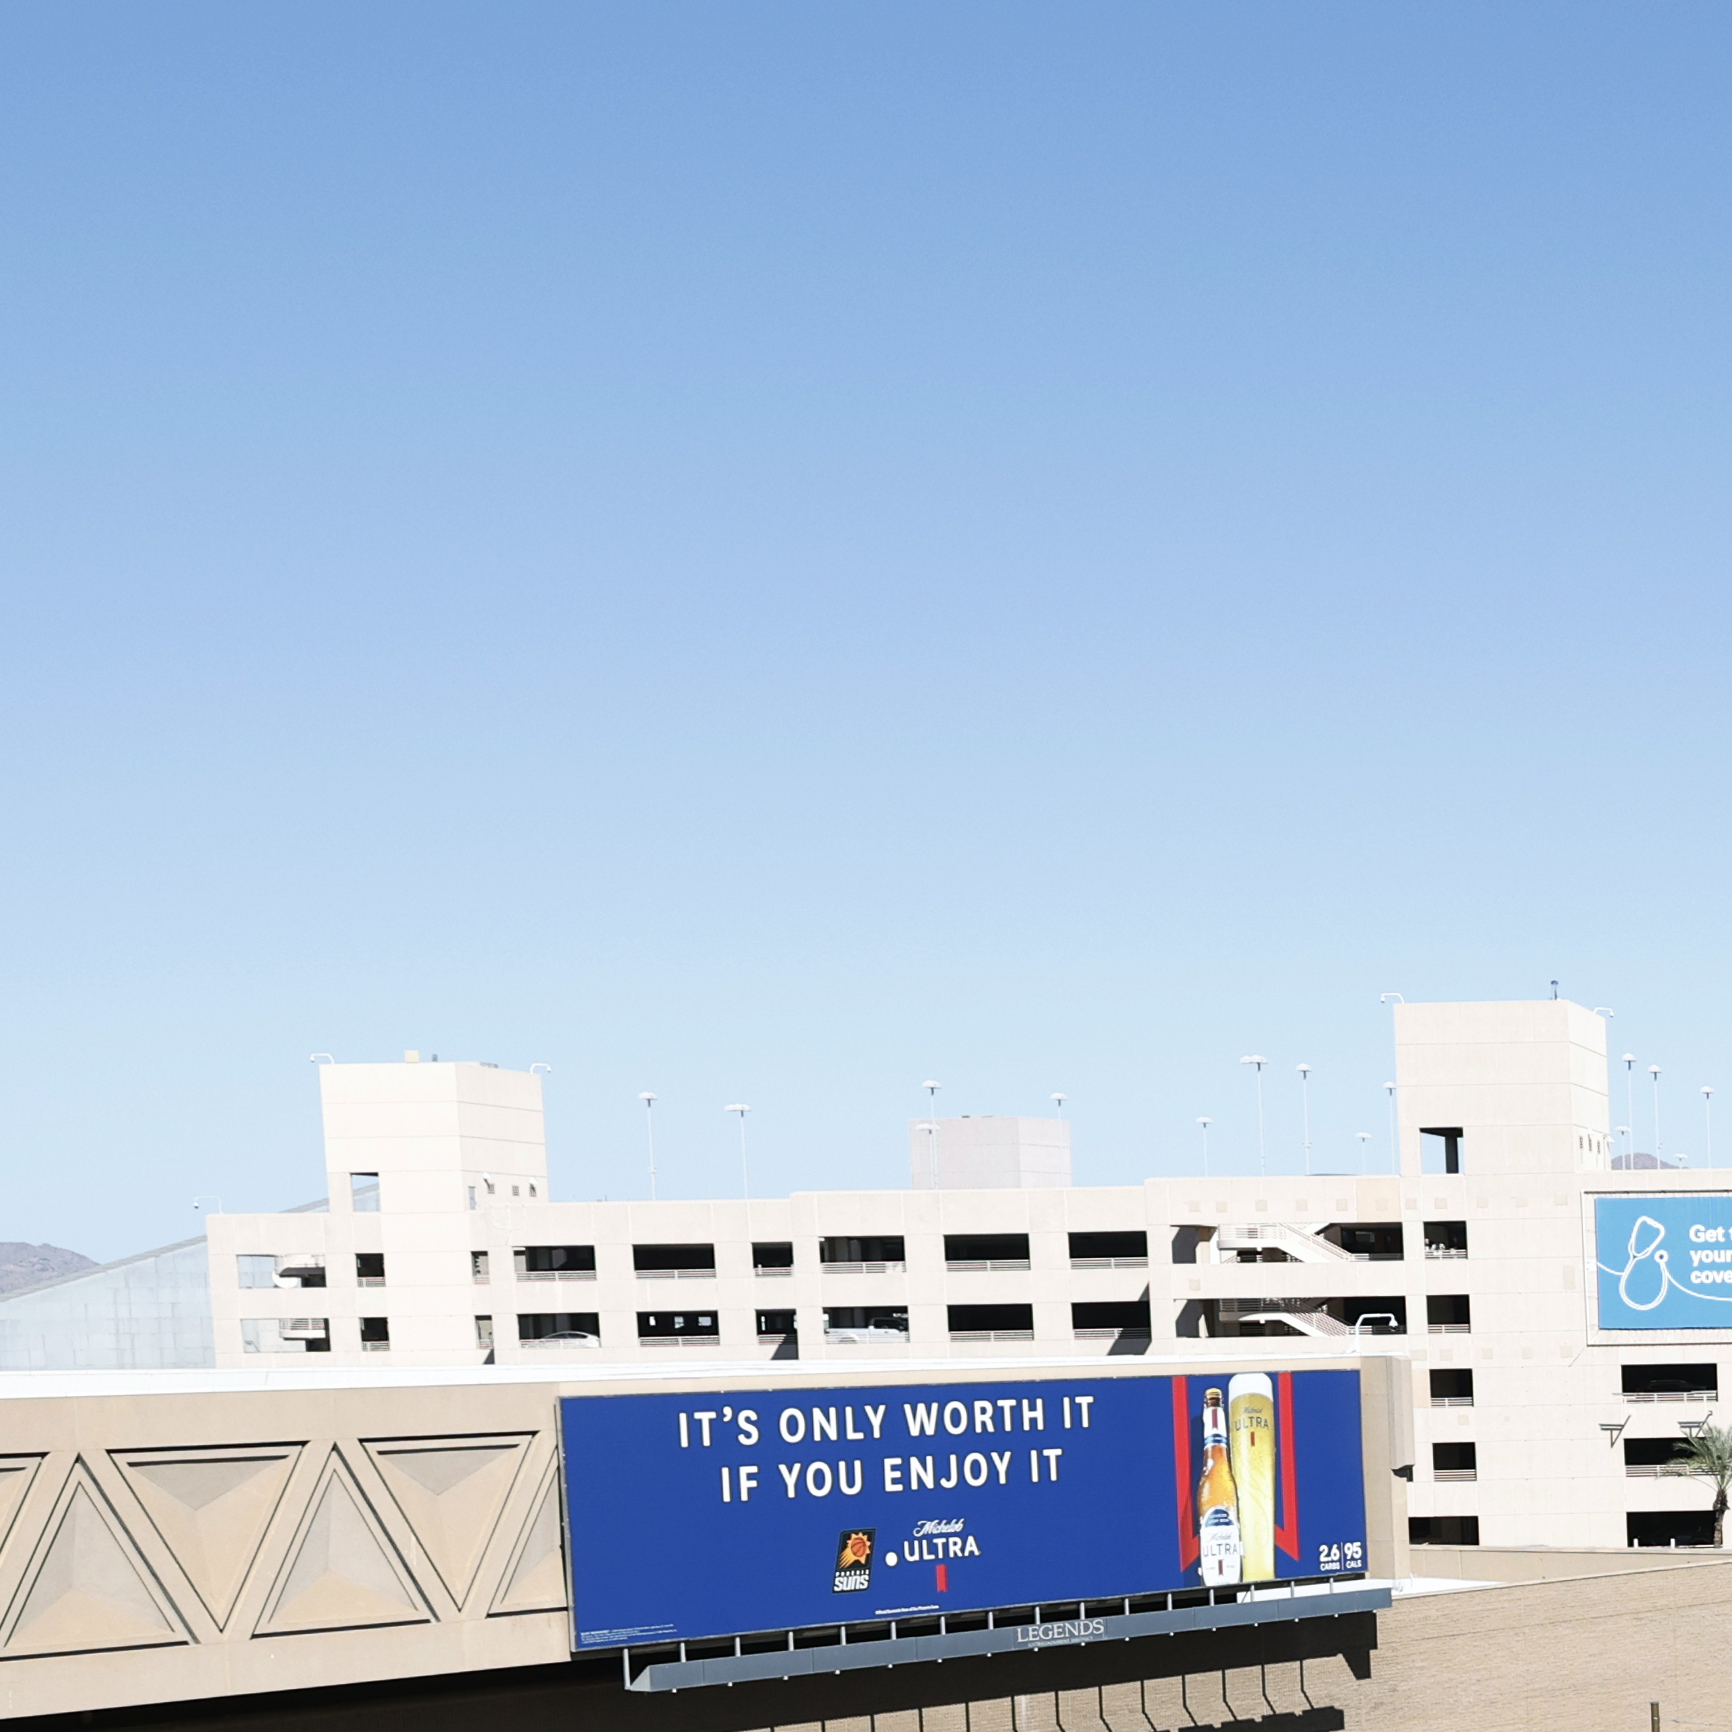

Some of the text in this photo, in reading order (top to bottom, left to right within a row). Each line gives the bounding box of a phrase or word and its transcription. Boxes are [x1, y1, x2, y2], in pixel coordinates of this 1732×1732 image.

[1689, 1224, 1726, 1243] Get
[678, 1395, 1095, 1448] IT'S ONLY WORTH IT
[1234, 1416, 1269, 1431] ULTRA
[721, 1447, 1063, 1503] IF YOU ENJOY IT
[913, 1517, 966, 1540] Michelob
[903, 1535, 981, 1563] ULTRA
[1202, 1541, 1239, 1558] ULTRA
[1319, 1543, 1340, 1562] 2.6
[1344, 1541, 1362, 1560] 95
[1320, 1561, 1340, 1572] CARBS
[1346, 1559, 1362, 1569] CALS
[1017, 1619, 1105, 1644] LEGENDS
